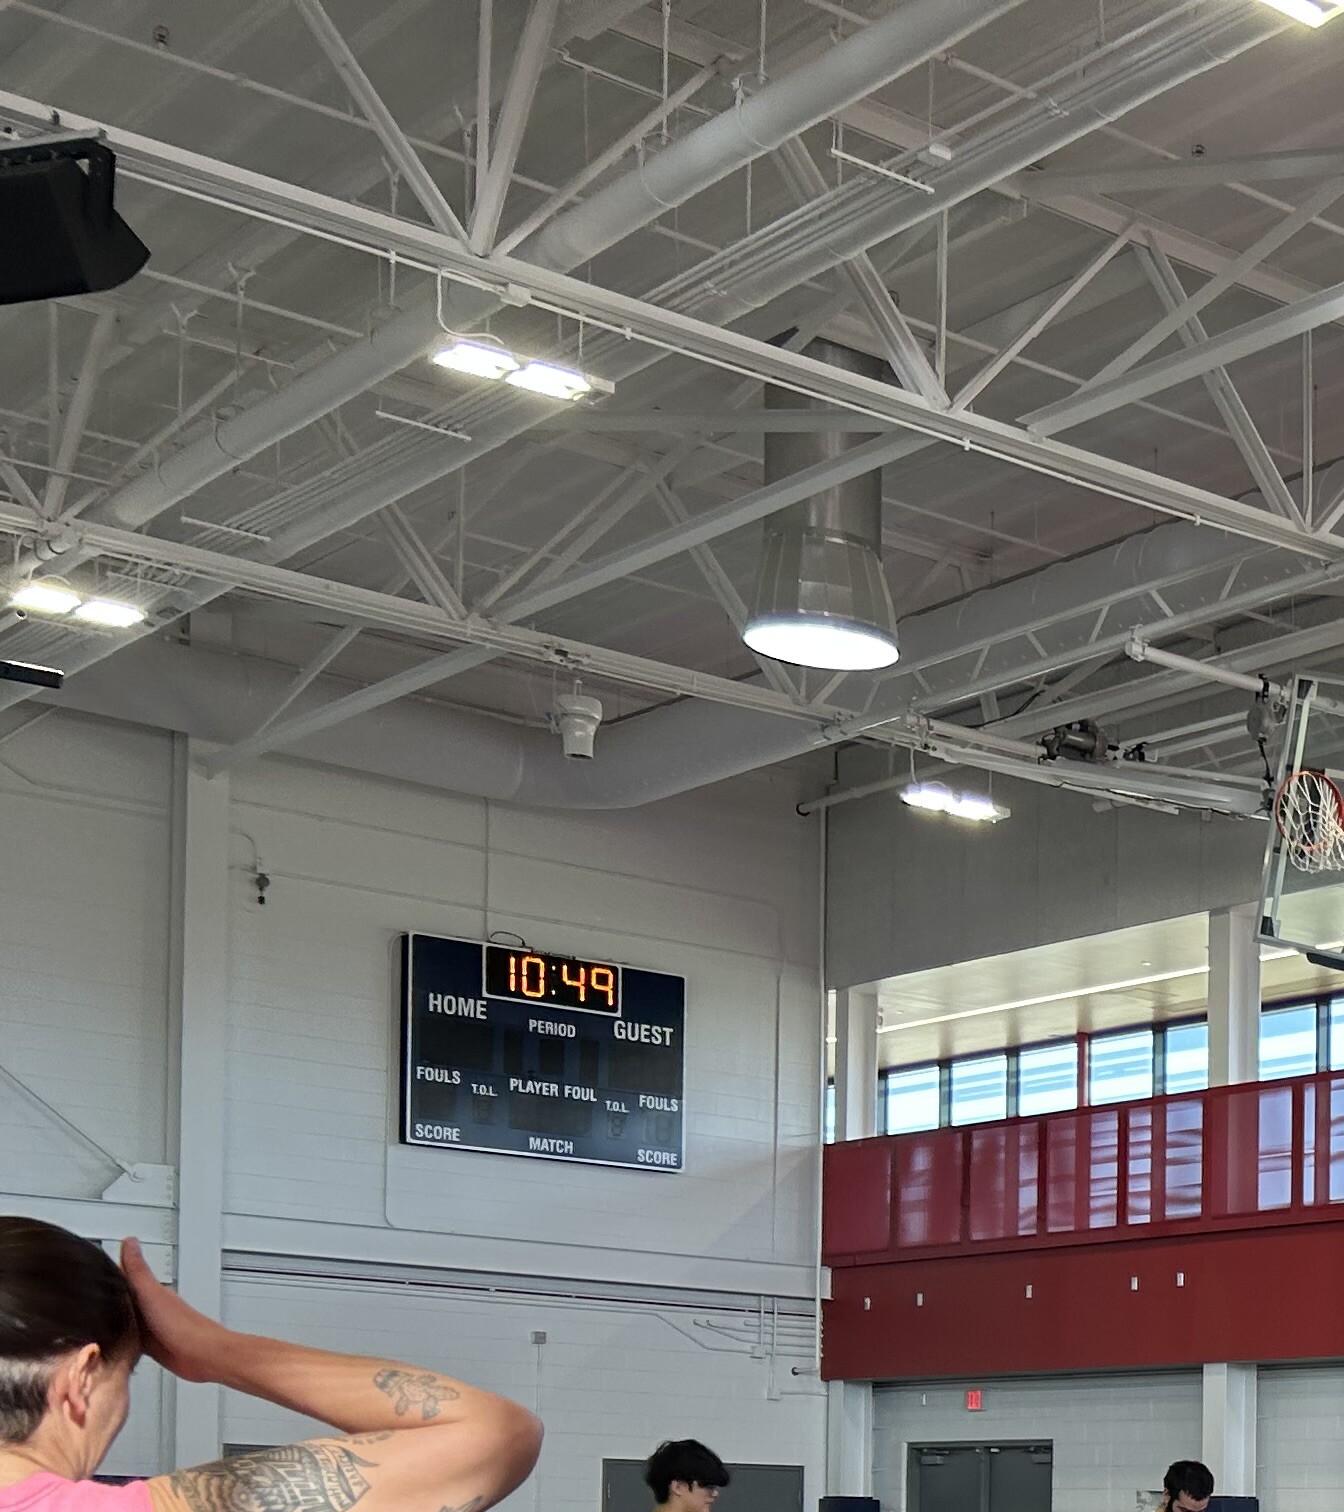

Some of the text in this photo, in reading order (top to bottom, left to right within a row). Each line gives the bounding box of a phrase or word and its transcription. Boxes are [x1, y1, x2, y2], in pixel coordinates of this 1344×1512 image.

[509, 954, 614, 1006] 10:49
[428, 992, 488, 1019] HOME
[528, 1018, 577, 1039] PERIOD
[613, 1019, 674, 1046] GUEST
[416, 1065, 461, 1085] FOULS
[509, 1078, 598, 1102] PLAYER FOUL
[638, 1094, 679, 1113] FOULS
[415, 1123, 461, 1142] SCORE
[529, 1136, 574, 1154] MATCH
[637, 1148, 678, 1166] SCORE
